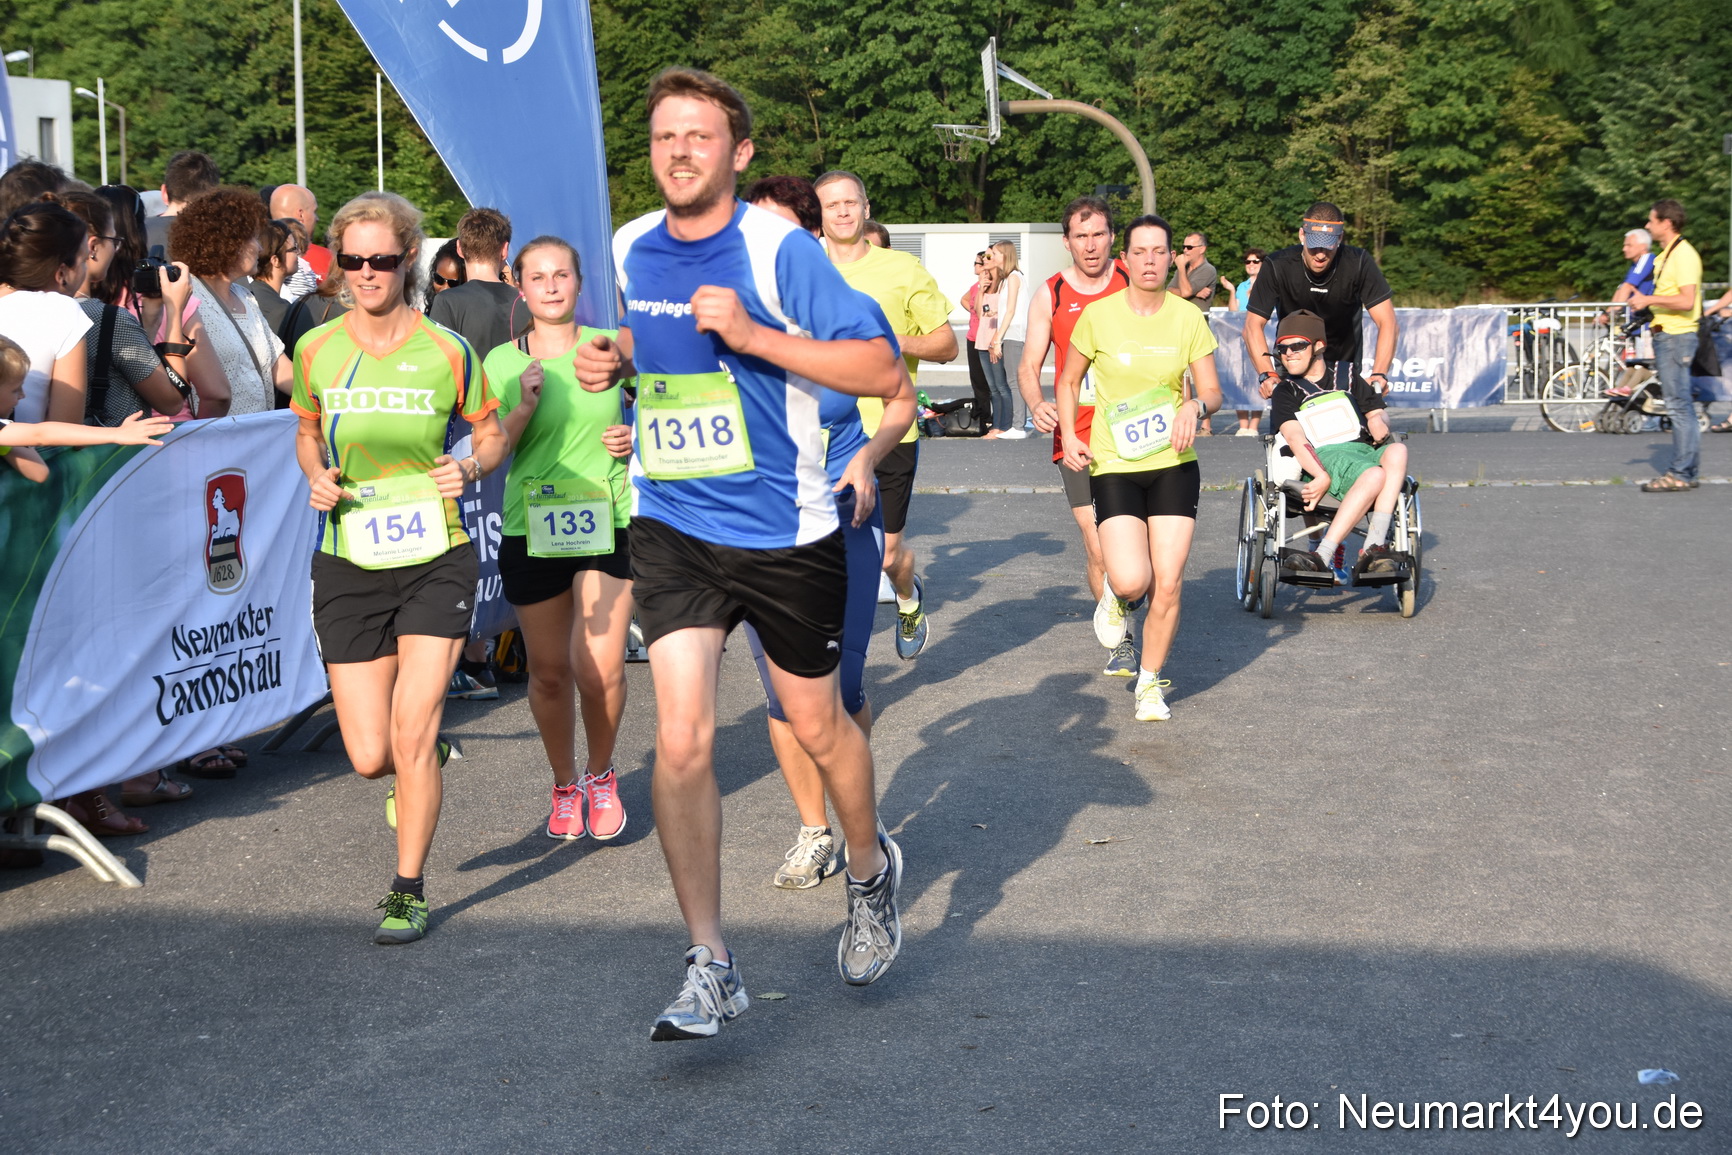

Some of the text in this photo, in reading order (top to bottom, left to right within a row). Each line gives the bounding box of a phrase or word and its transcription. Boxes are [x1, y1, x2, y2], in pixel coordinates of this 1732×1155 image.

[323, 386, 436, 414] BOCK
[648, 414, 734, 450] 1318
[1124, 413, 1167, 443] 673
[364, 511, 427, 545] 154
[543, 509, 596, 536] 133
[213, 563, 235, 582] 1628
